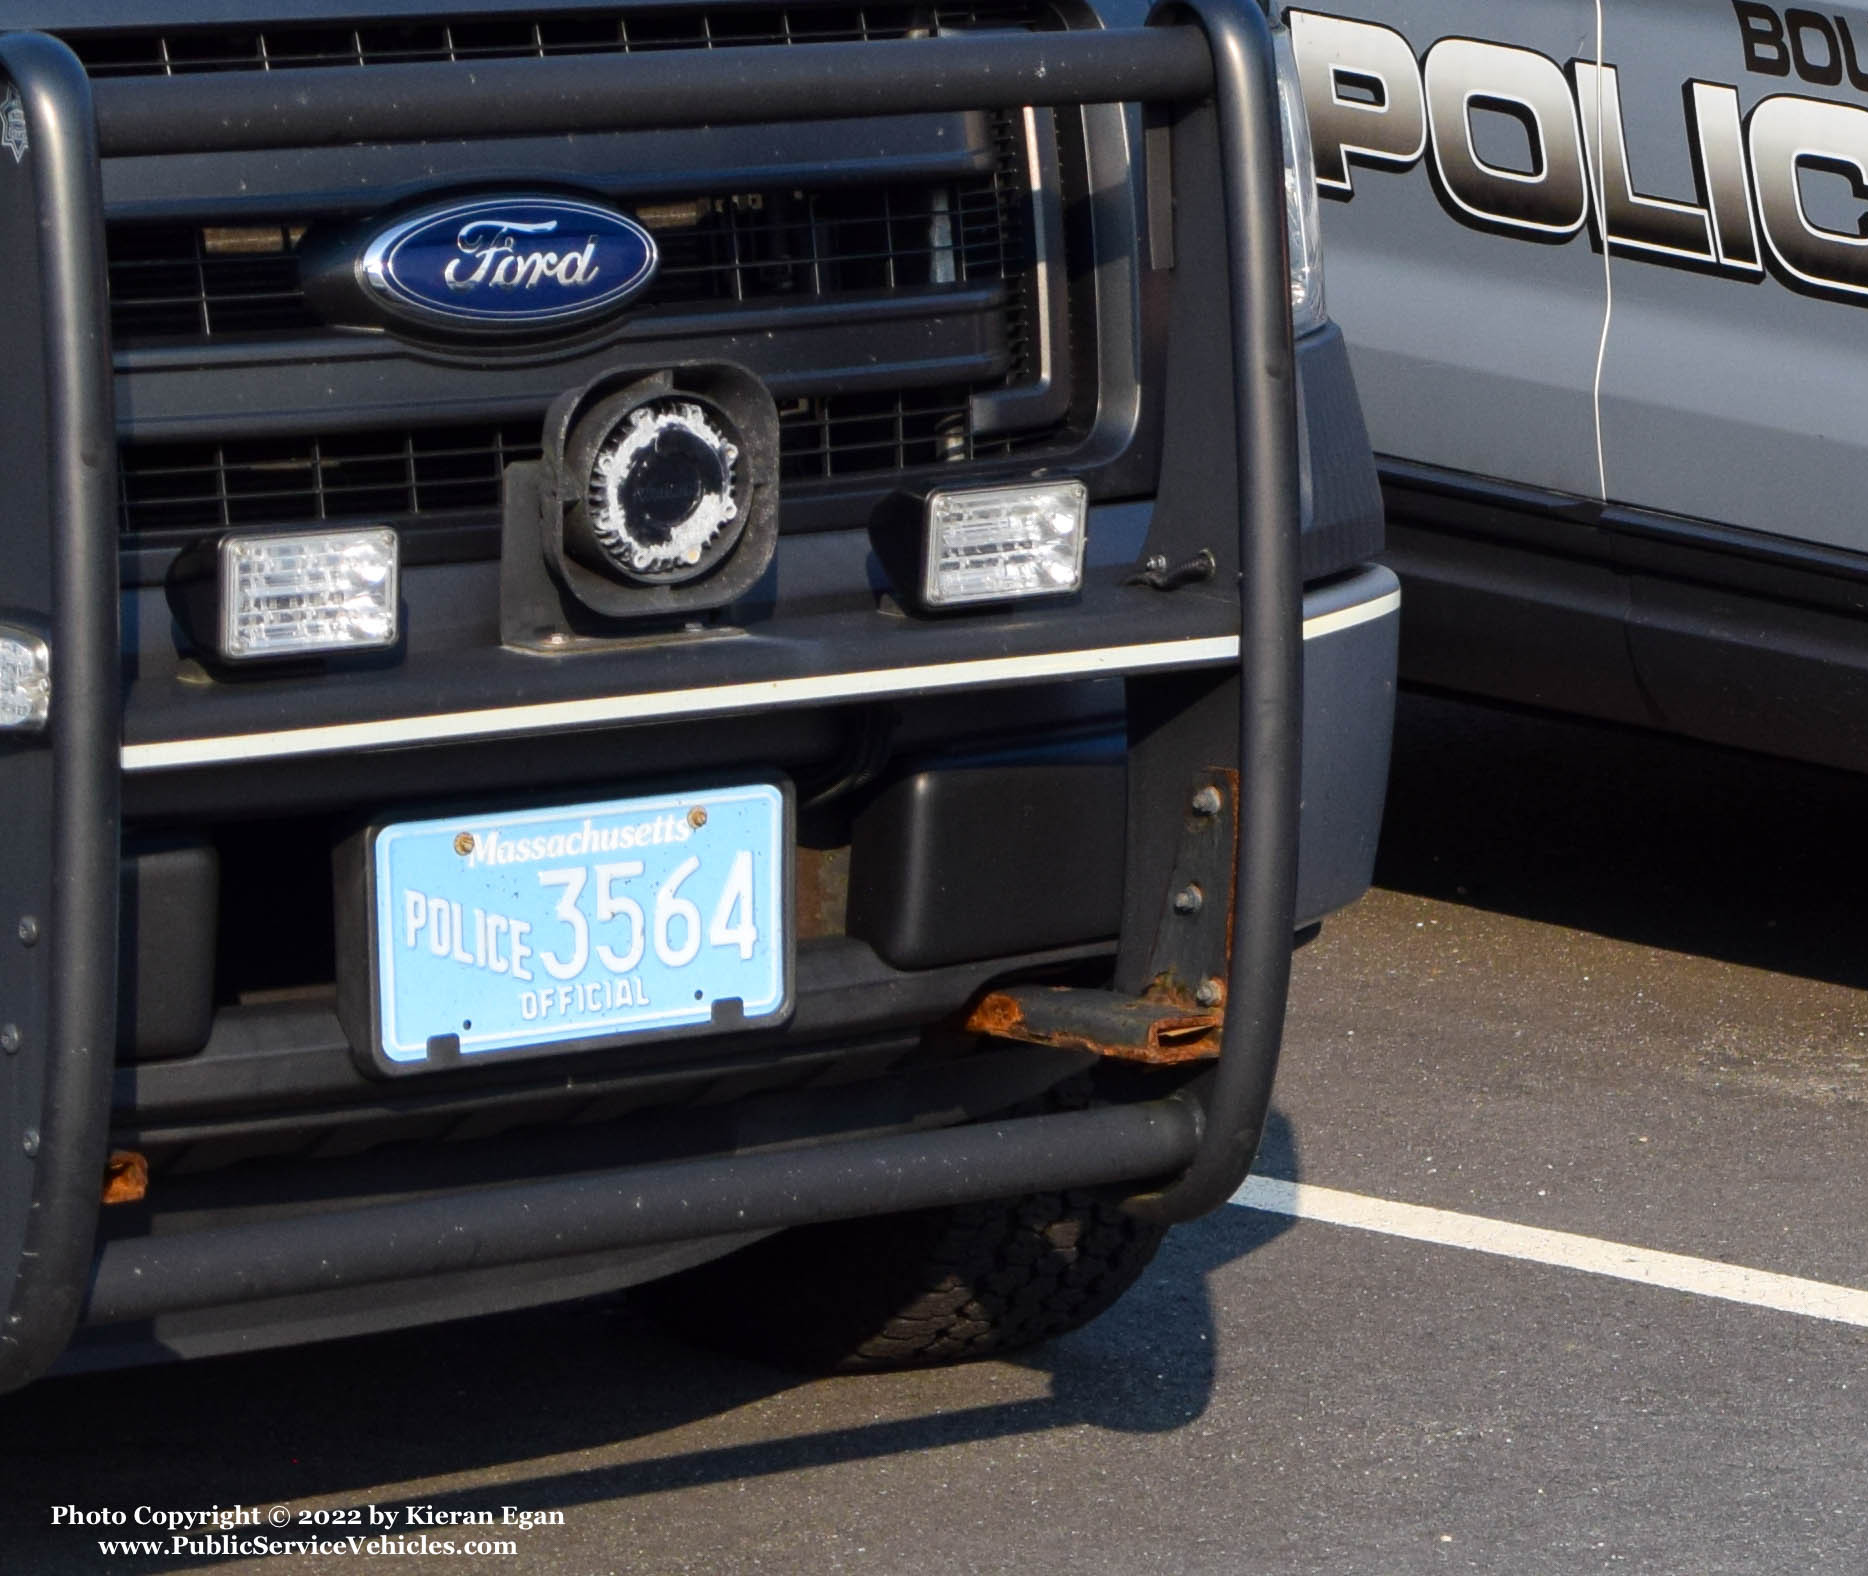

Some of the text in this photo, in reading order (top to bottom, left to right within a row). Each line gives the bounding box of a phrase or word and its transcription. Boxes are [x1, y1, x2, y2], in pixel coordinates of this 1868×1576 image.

[443, 218, 599, 291] Ford
[468, 813, 692, 867] Massachusetts
[404, 849, 758, 981] POLICE 3564
[520, 975, 651, 1021] OFFICIAL
